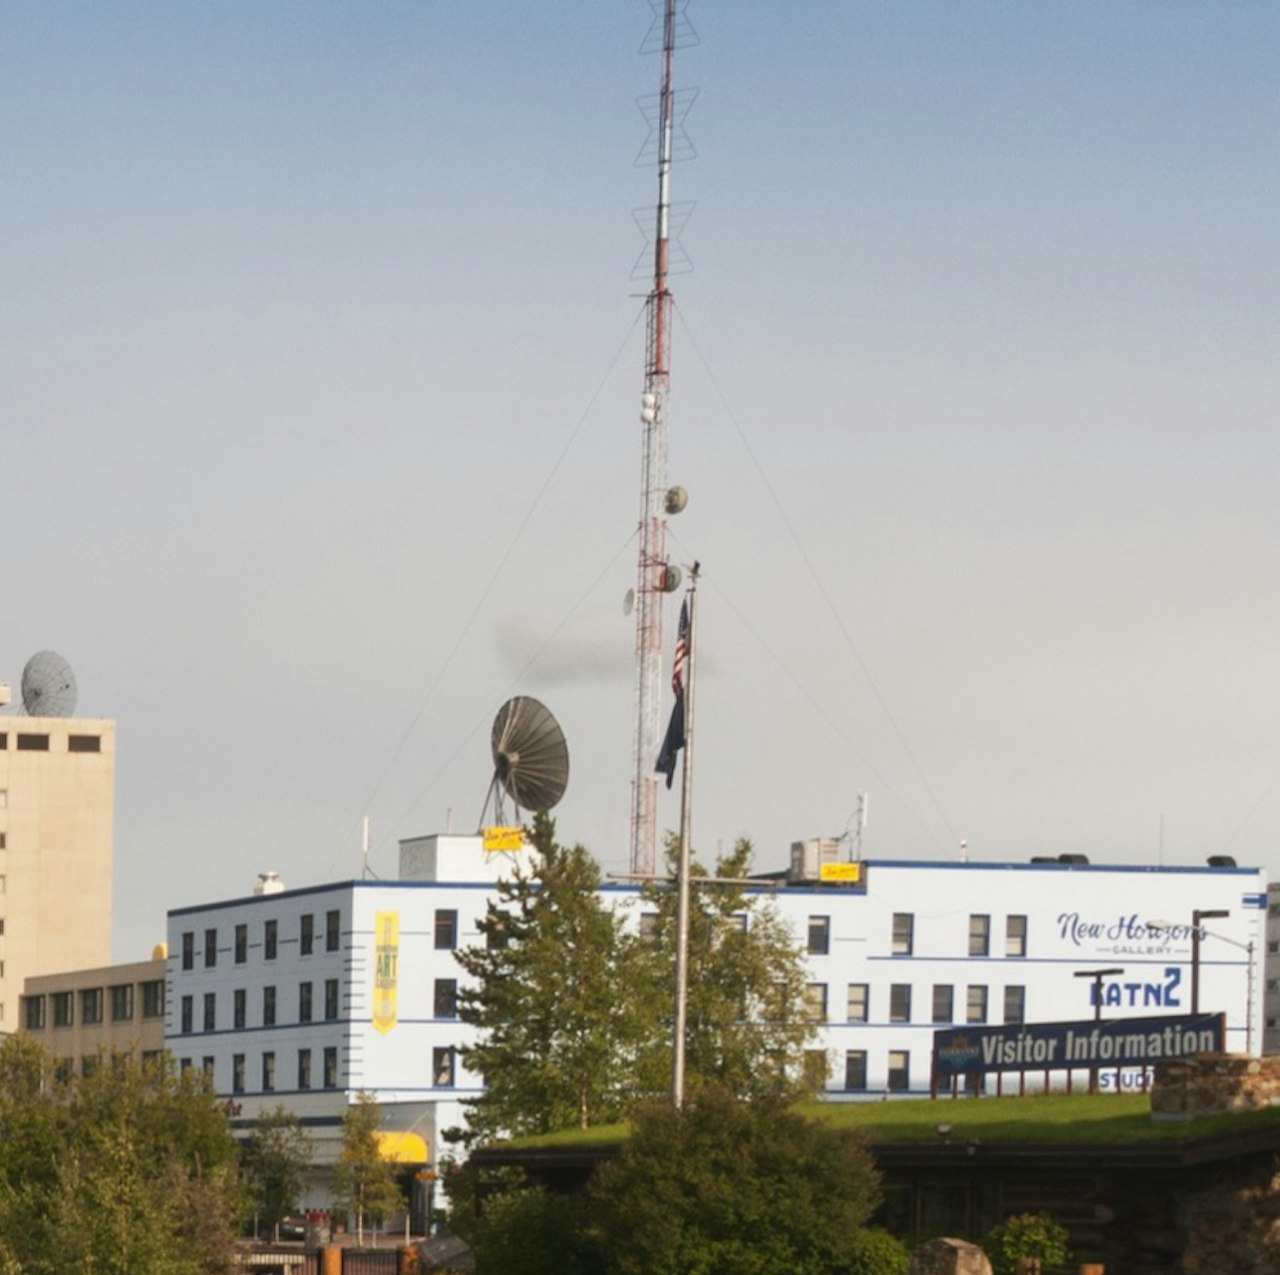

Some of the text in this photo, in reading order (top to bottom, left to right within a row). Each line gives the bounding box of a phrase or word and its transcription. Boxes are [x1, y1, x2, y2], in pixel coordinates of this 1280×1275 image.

[1057, 912, 1105, 946] New
[1112, 946, 1173, 955] GALLERY
[981, 1033, 1058, 1065] Visitor
[1065, 1024, 1214, 1061] Information
